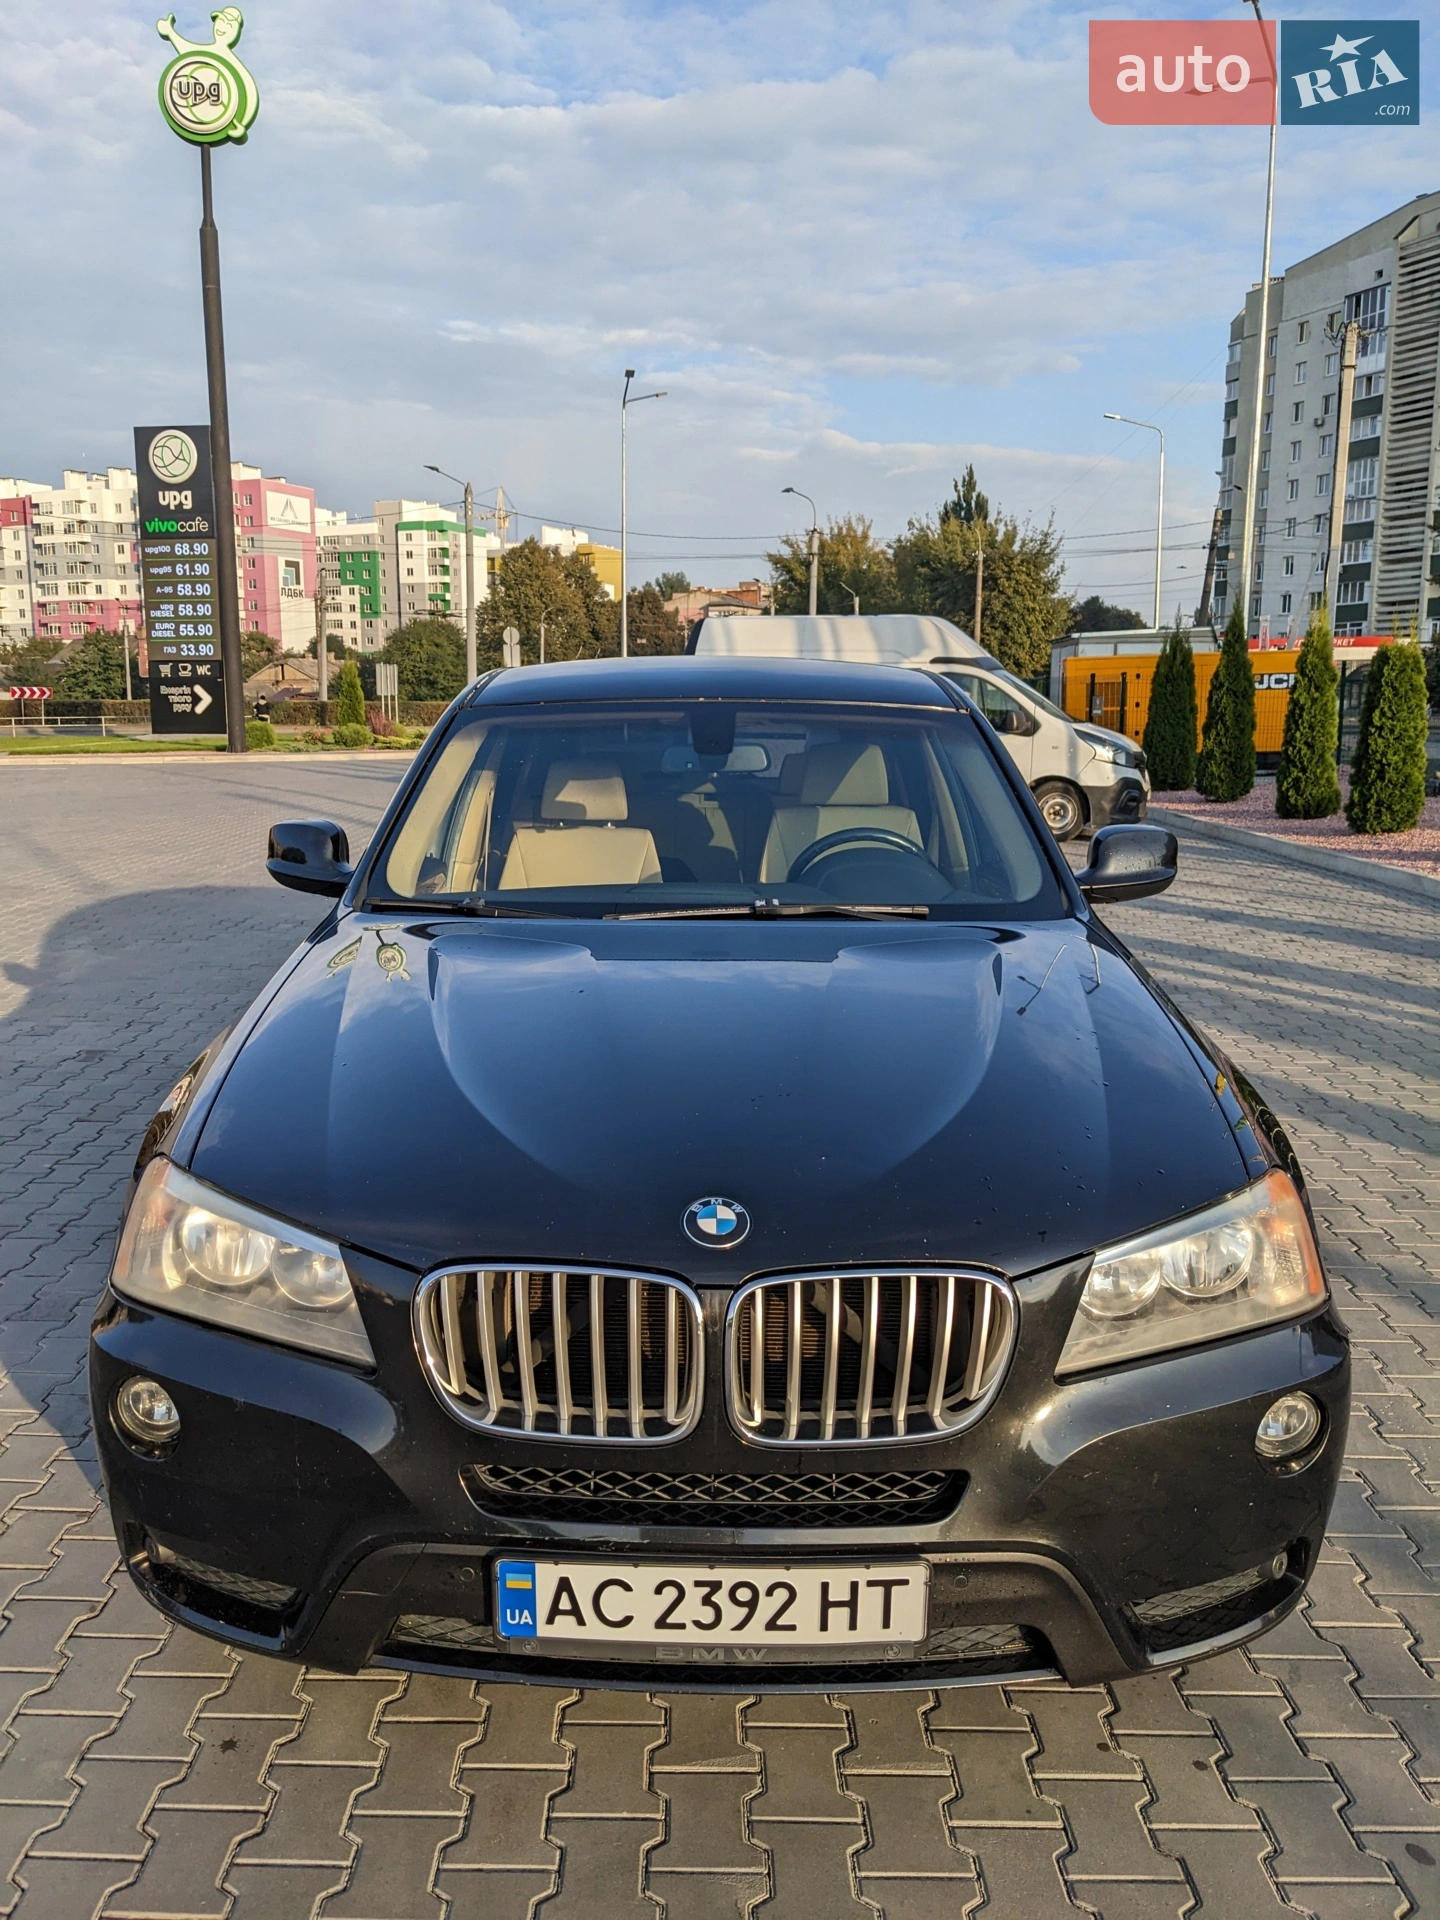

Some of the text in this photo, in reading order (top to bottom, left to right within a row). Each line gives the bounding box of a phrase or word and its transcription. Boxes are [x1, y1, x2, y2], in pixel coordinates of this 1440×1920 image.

[178, 81, 221, 105] upg
[158, 490, 193, 510] upg
[145, 543, 209, 556] upg100 68.90
[150, 563, 210, 576] upg95 61.90
[177, 583, 211, 596] 58.90
[150, 610, 175, 618] DIESEL
[178, 603, 212, 616] 58.90
[155, 622, 175, 630] EURO
[179, 623, 213, 636] 55.90
[151, 630, 176, 638] DIESEL
[180, 643, 214, 656] 33.90
[196, 664, 211, 676] WC
[690, 1198, 744, 1213] BMW
[545, 1576, 910, 1632] AC 2392 HT
[506, 1608, 534, 1625] UA
[655, 1646, 768, 1661] BMW
